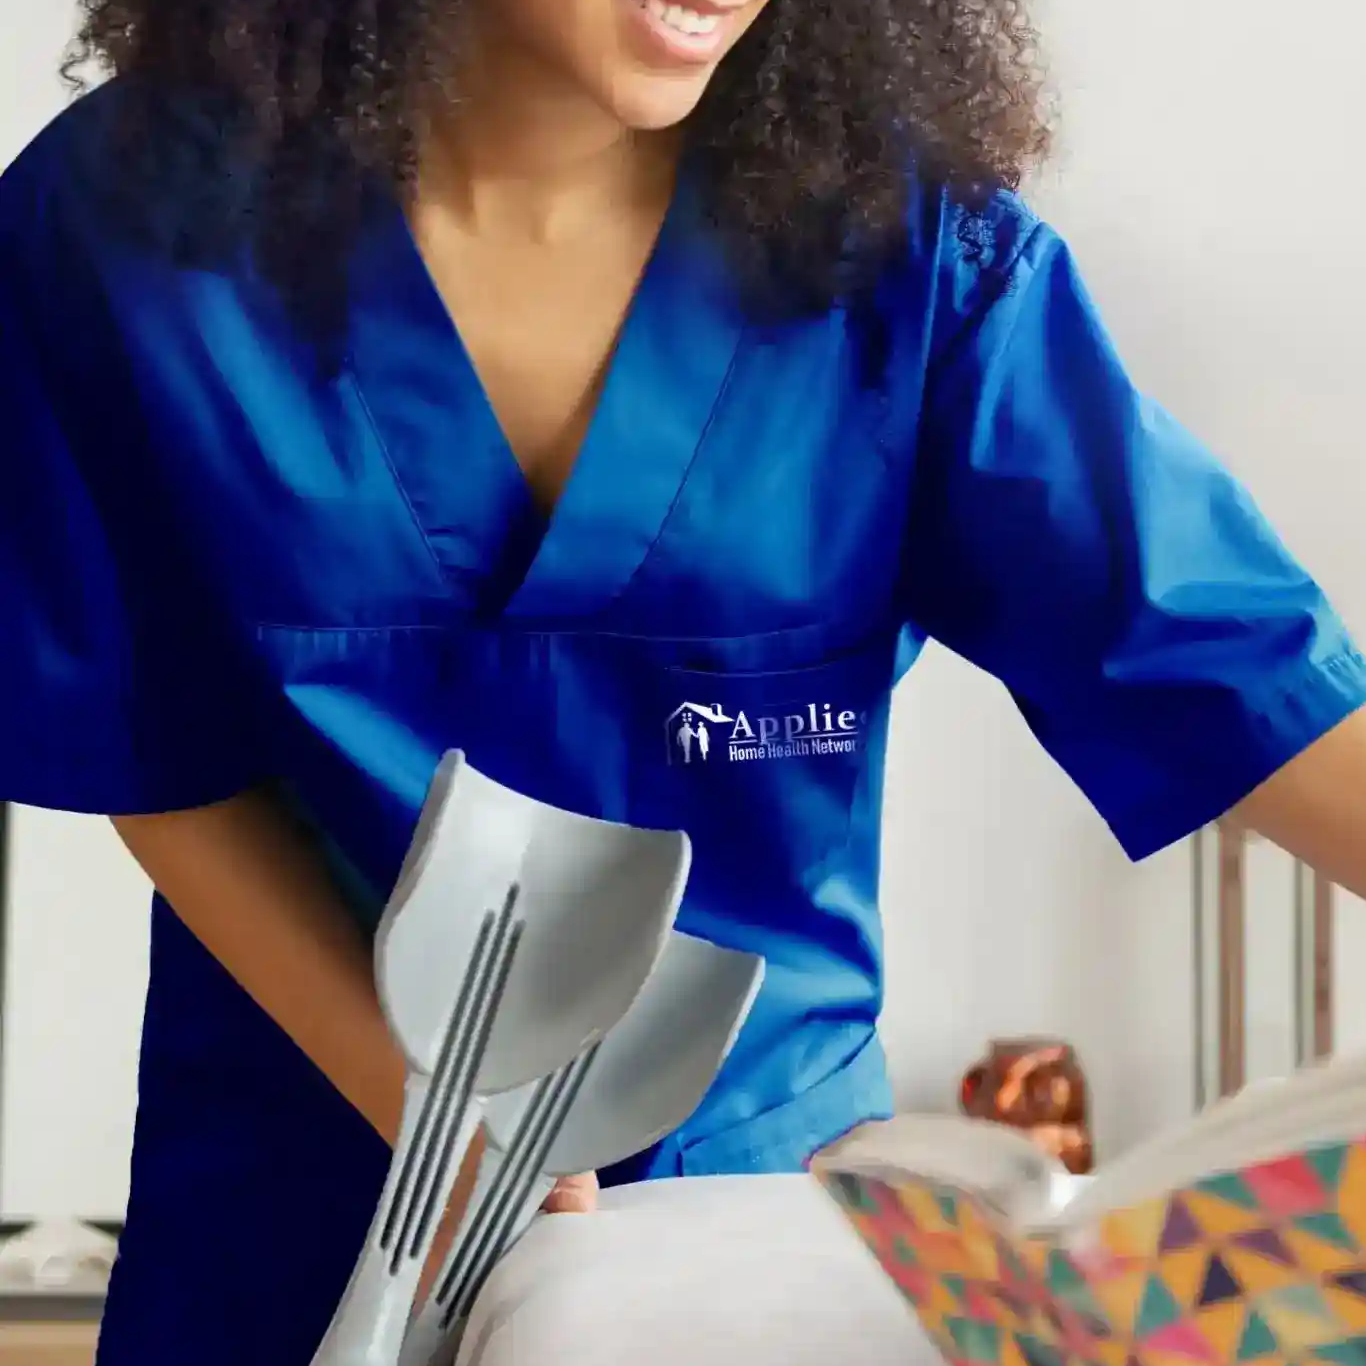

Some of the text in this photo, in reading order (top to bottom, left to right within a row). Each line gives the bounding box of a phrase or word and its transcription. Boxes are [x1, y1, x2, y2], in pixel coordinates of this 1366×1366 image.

[729, 703, 866, 745] Applie
[729, 738, 857, 762] Home Health Networ
